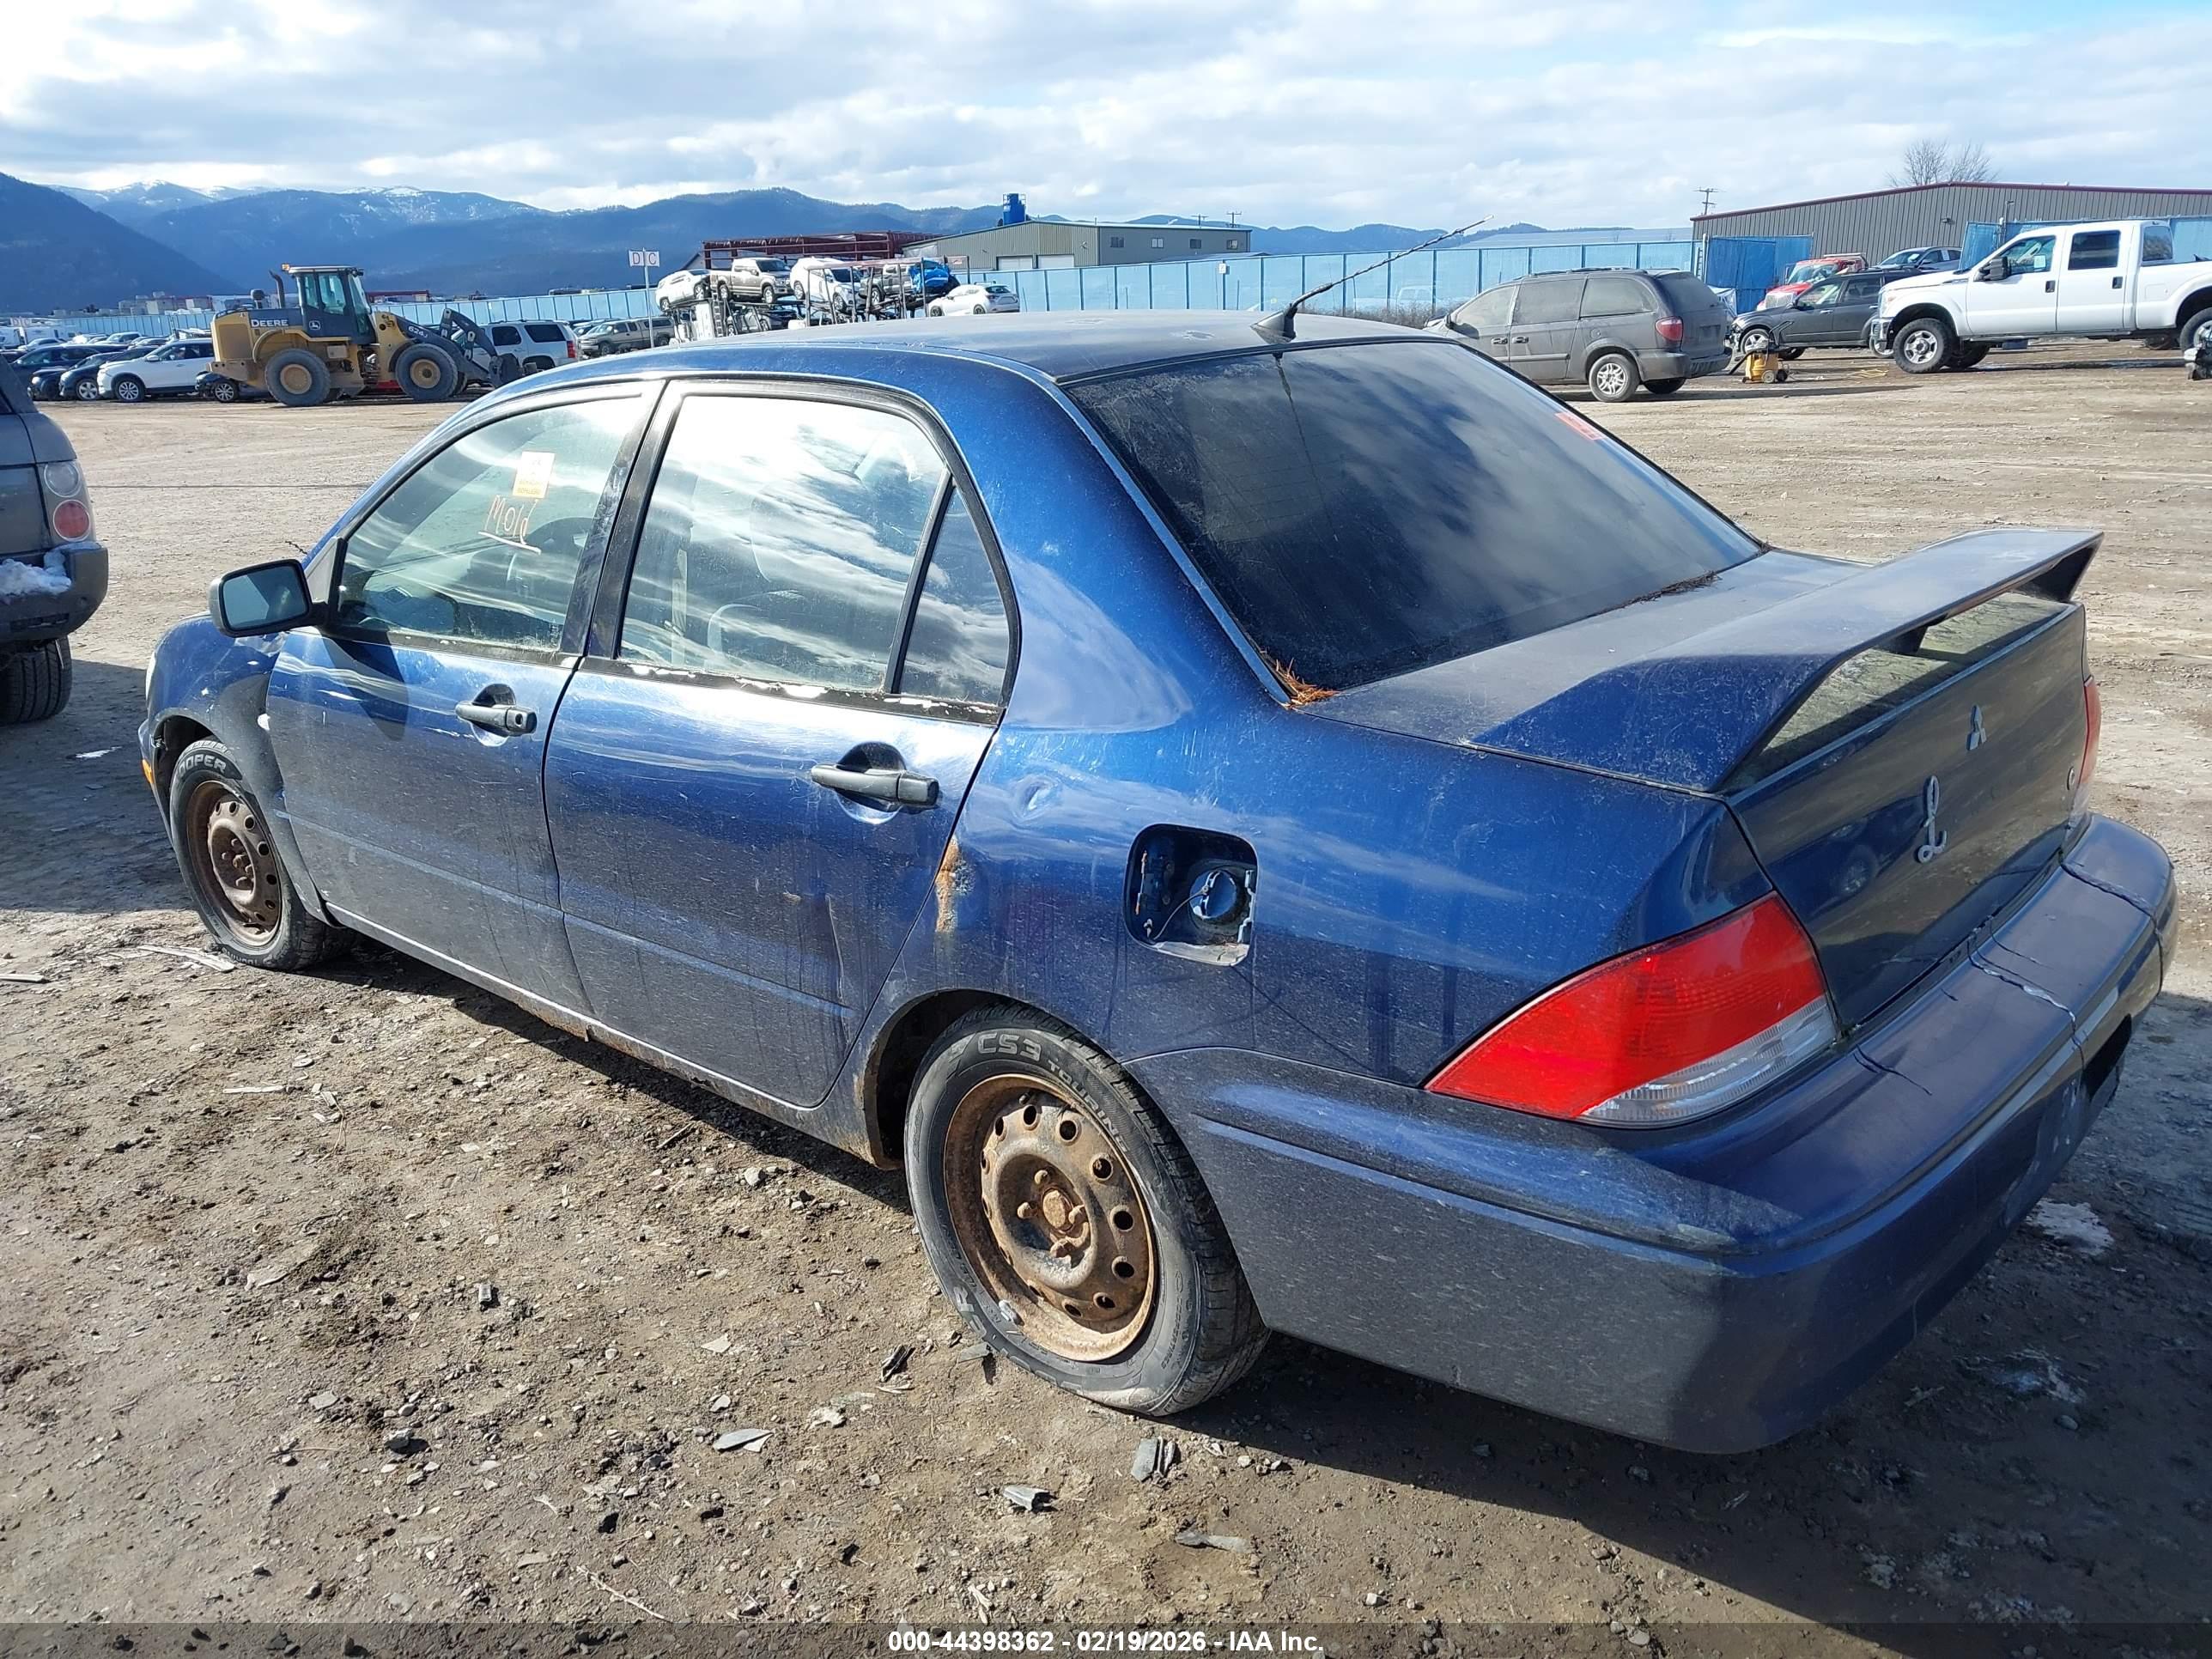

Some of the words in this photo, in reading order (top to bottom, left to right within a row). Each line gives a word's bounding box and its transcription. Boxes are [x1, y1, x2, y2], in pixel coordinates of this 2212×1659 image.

[632, 252, 641, 264] D
[648, 252, 657, 265] C
[251, 319, 289, 328] DEERE
[977, 1031, 1042, 1061] CS3
[1048, 1059, 1129, 1152] TOURING
